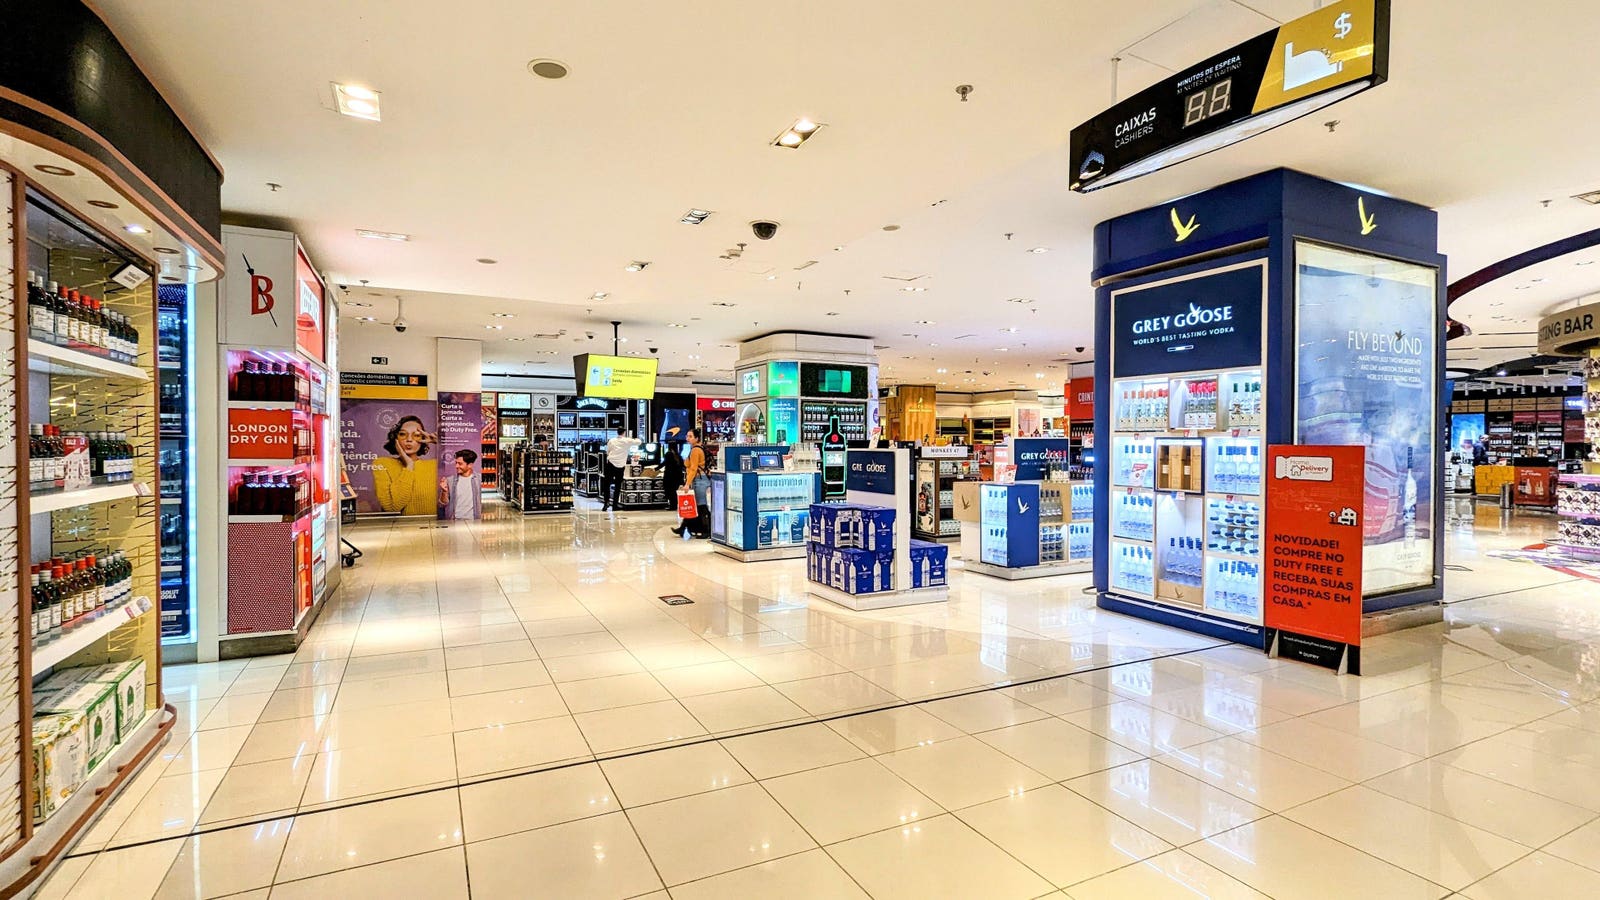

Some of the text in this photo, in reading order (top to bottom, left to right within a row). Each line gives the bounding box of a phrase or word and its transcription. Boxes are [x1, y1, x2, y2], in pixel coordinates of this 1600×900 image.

[1177, 55, 1240, 88] MINUTOS DE ESPERA
[1177, 78, 1204, 95] MINUTES
[1214, 61, 1242, 78] WAITING
[1115, 106, 1157, 137] CAIXAS
[1114, 124, 1154, 148] CASHIERS
[1132, 305, 1232, 334] GREY GOOSE
[1564, 314, 1594, 334] BAR
[1133, 326, 1234, 345] WORLD'S BEST TASTING VODKA
[1348, 330, 1422, 355] FLY BEYOND
[230, 424, 288, 434] LONDON
[230, 435, 288, 444] DRY GIN
[866, 462, 886, 472] GOOSE
[1274, 534, 1339, 549] NOVIDADE!
[1273, 546, 1344, 563] COMPRE NO
[1273, 558, 1343, 576] DUTY FREE E
[1273, 571, 1354, 591] RECEBA SUAS
[1273, 583, 1351, 604] COMPRAS EM
